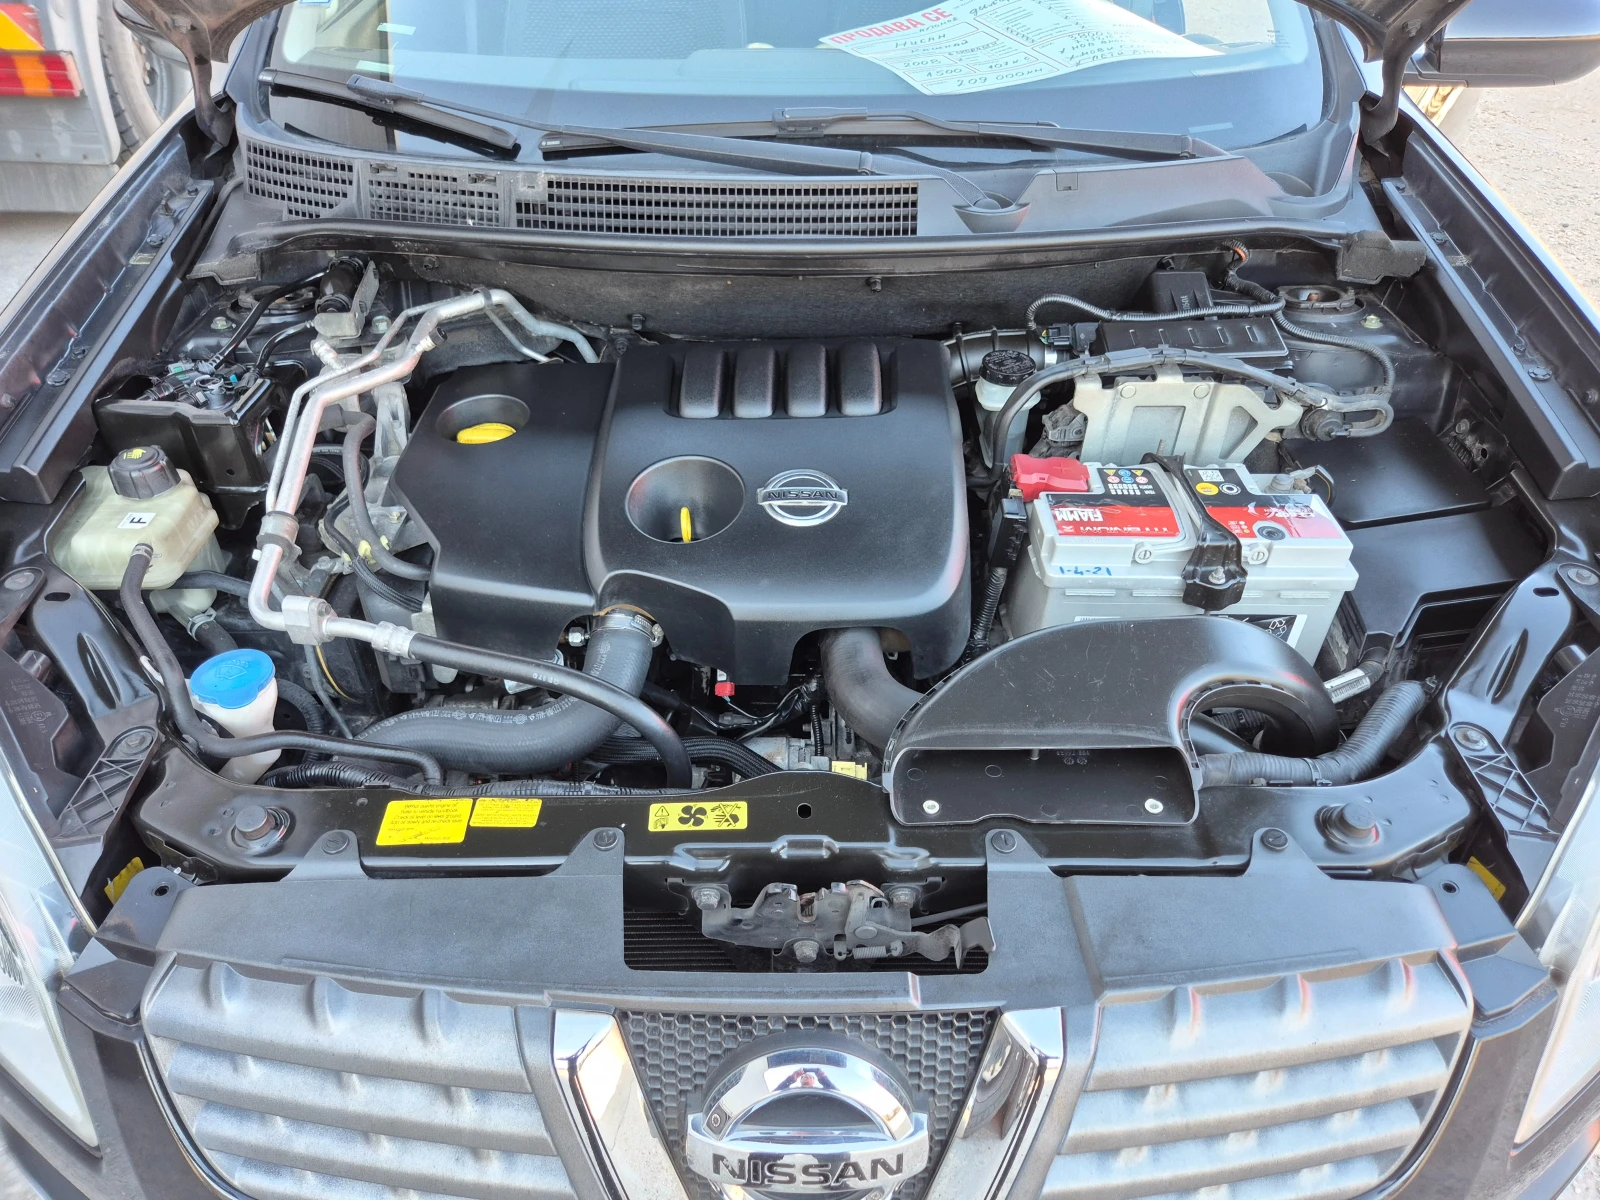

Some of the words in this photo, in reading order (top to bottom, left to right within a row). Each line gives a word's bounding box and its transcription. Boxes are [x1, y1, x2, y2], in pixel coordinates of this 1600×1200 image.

[828, 18, 926, 44] ПРОДАВА
[921, 7, 953, 22] СЕ
[926, 68, 963, 77] 1500
[956, 76, 988, 87] 209
[767, 490, 839, 499] NISSAN
[129, 516, 147, 525] F
[1054, 508, 1104, 522] FIAMM
[1059, 565, 1112, 577] 1-4-21
[711, 1152, 905, 1186] NISSAN
